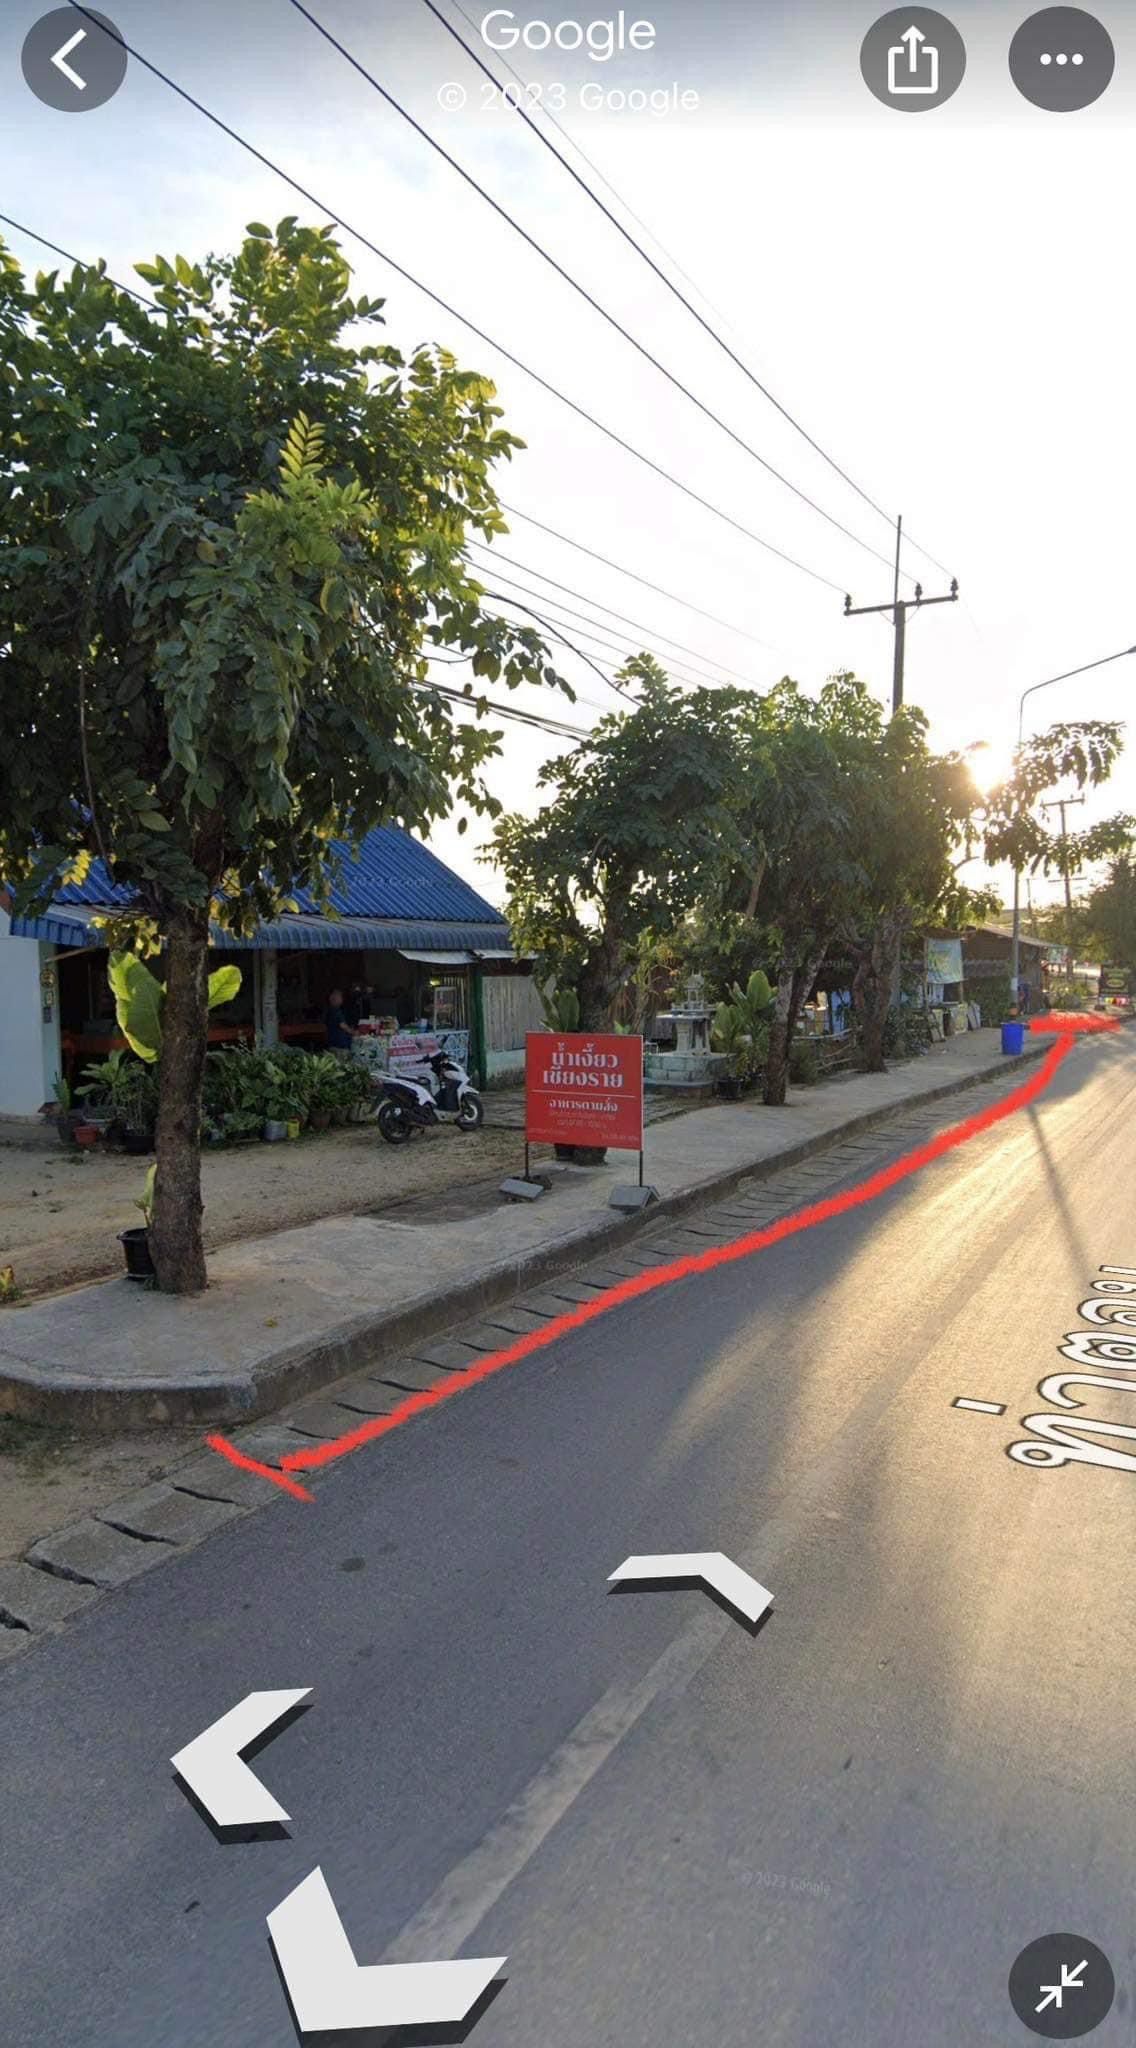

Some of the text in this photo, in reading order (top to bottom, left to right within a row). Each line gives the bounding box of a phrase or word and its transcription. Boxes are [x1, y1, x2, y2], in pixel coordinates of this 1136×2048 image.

[552, 1042, 619, 1069] น้ำเงี้ยว
[543, 1065, 624, 1089] เชียงราย
[549, 1097, 619, 1112] อาหารตามสั่ง
